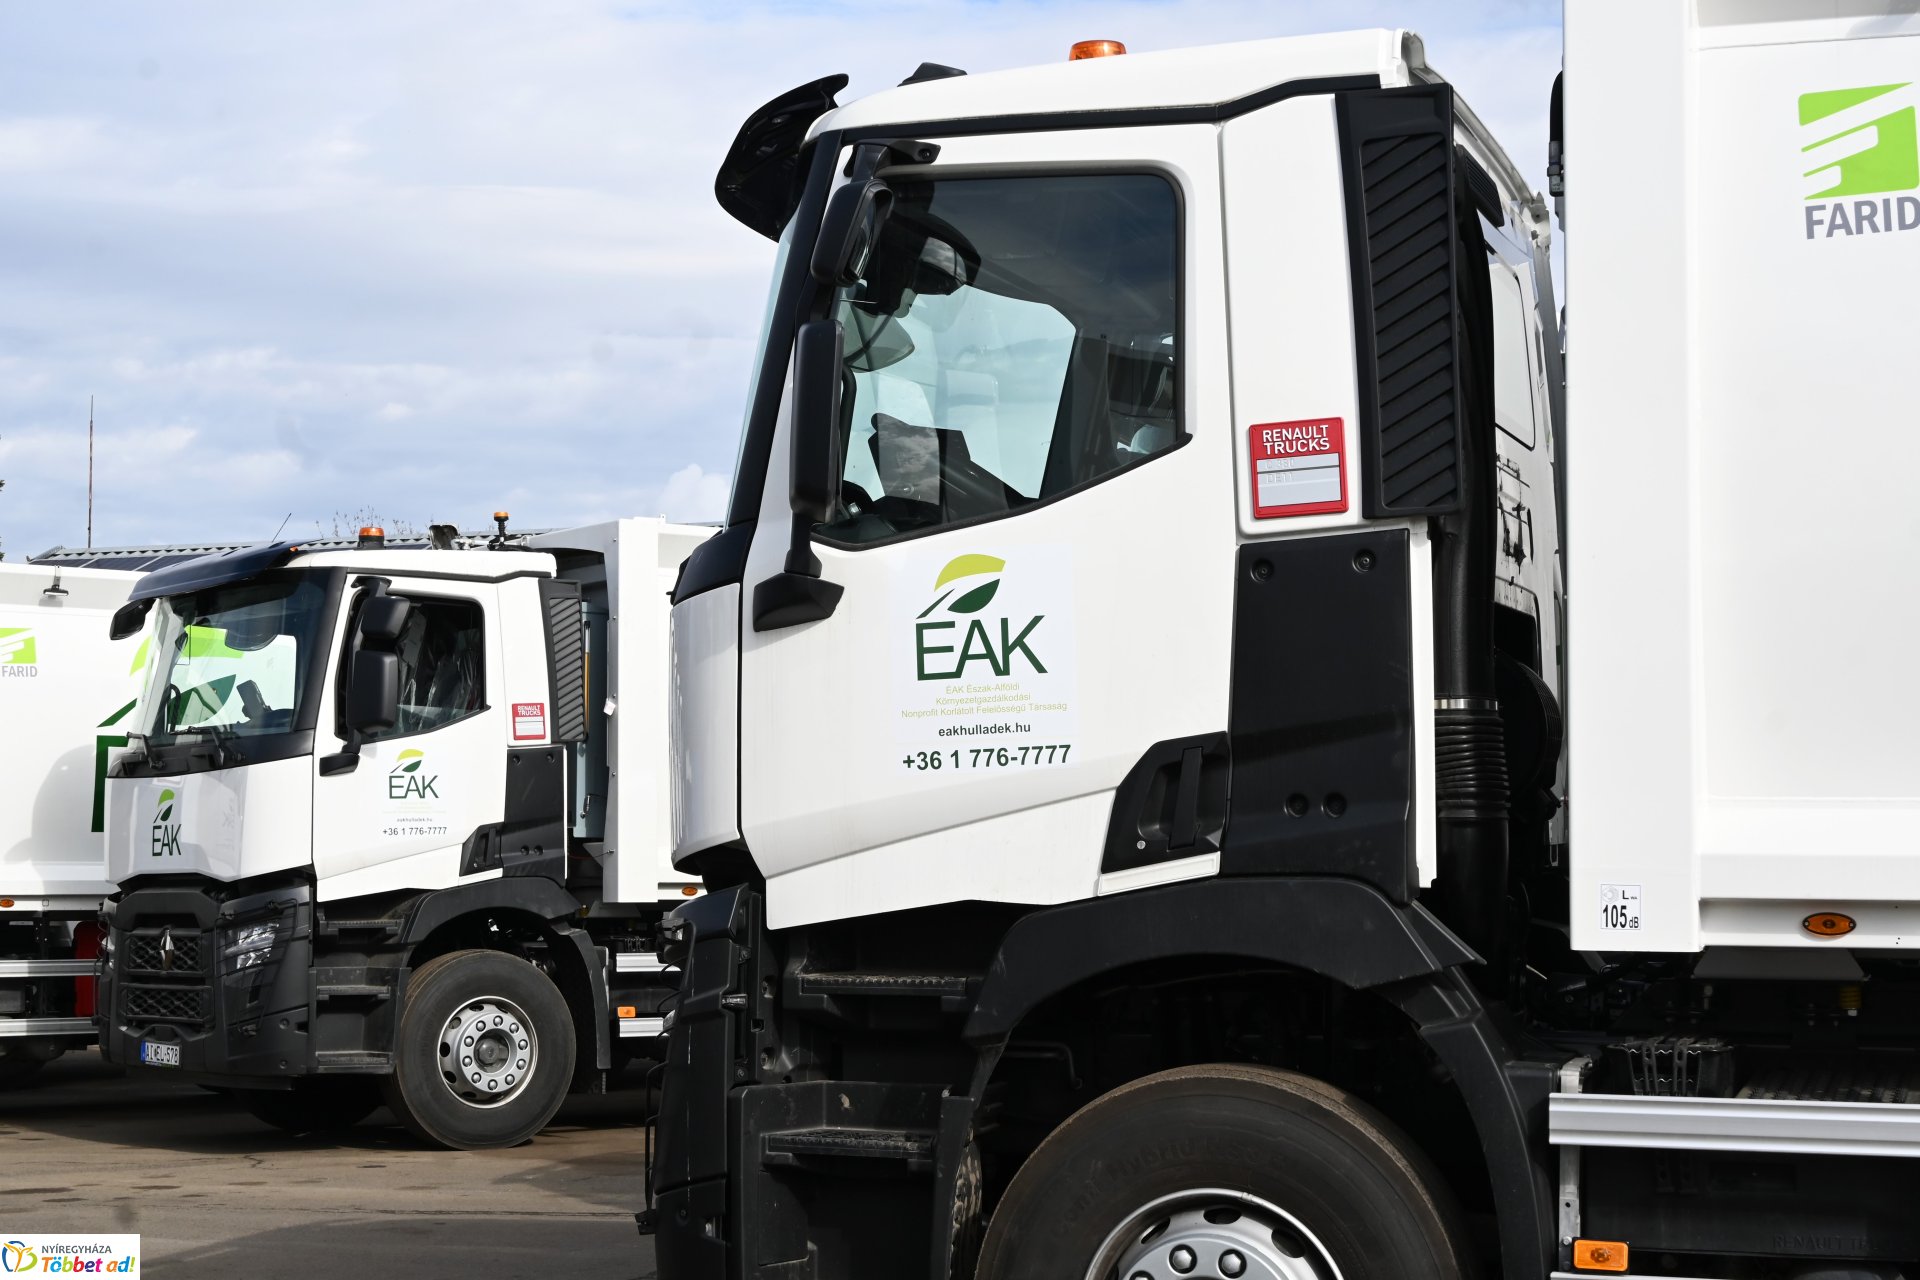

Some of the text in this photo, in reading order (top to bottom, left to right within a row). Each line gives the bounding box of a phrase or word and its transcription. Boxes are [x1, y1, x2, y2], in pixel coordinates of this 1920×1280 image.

[1805, 196, 1920, 240] FARID
[1262, 425, 1329, 442] RENAULT
[1264, 437, 1330, 455] TRUCKS
[1, 665, 38, 678] FARID
[901, 709, 938, 718] Nonprofit
[938, 722, 1031, 736] eakhulladek.hu
[902, 744, 1071, 770] +36 1 776-7777
[383, 827, 399, 836] +36
[409, 826, 448, 836] 776-7777
[1622, 889, 1629, 900] L
[1602, 904, 1639, 928] 105 dB
